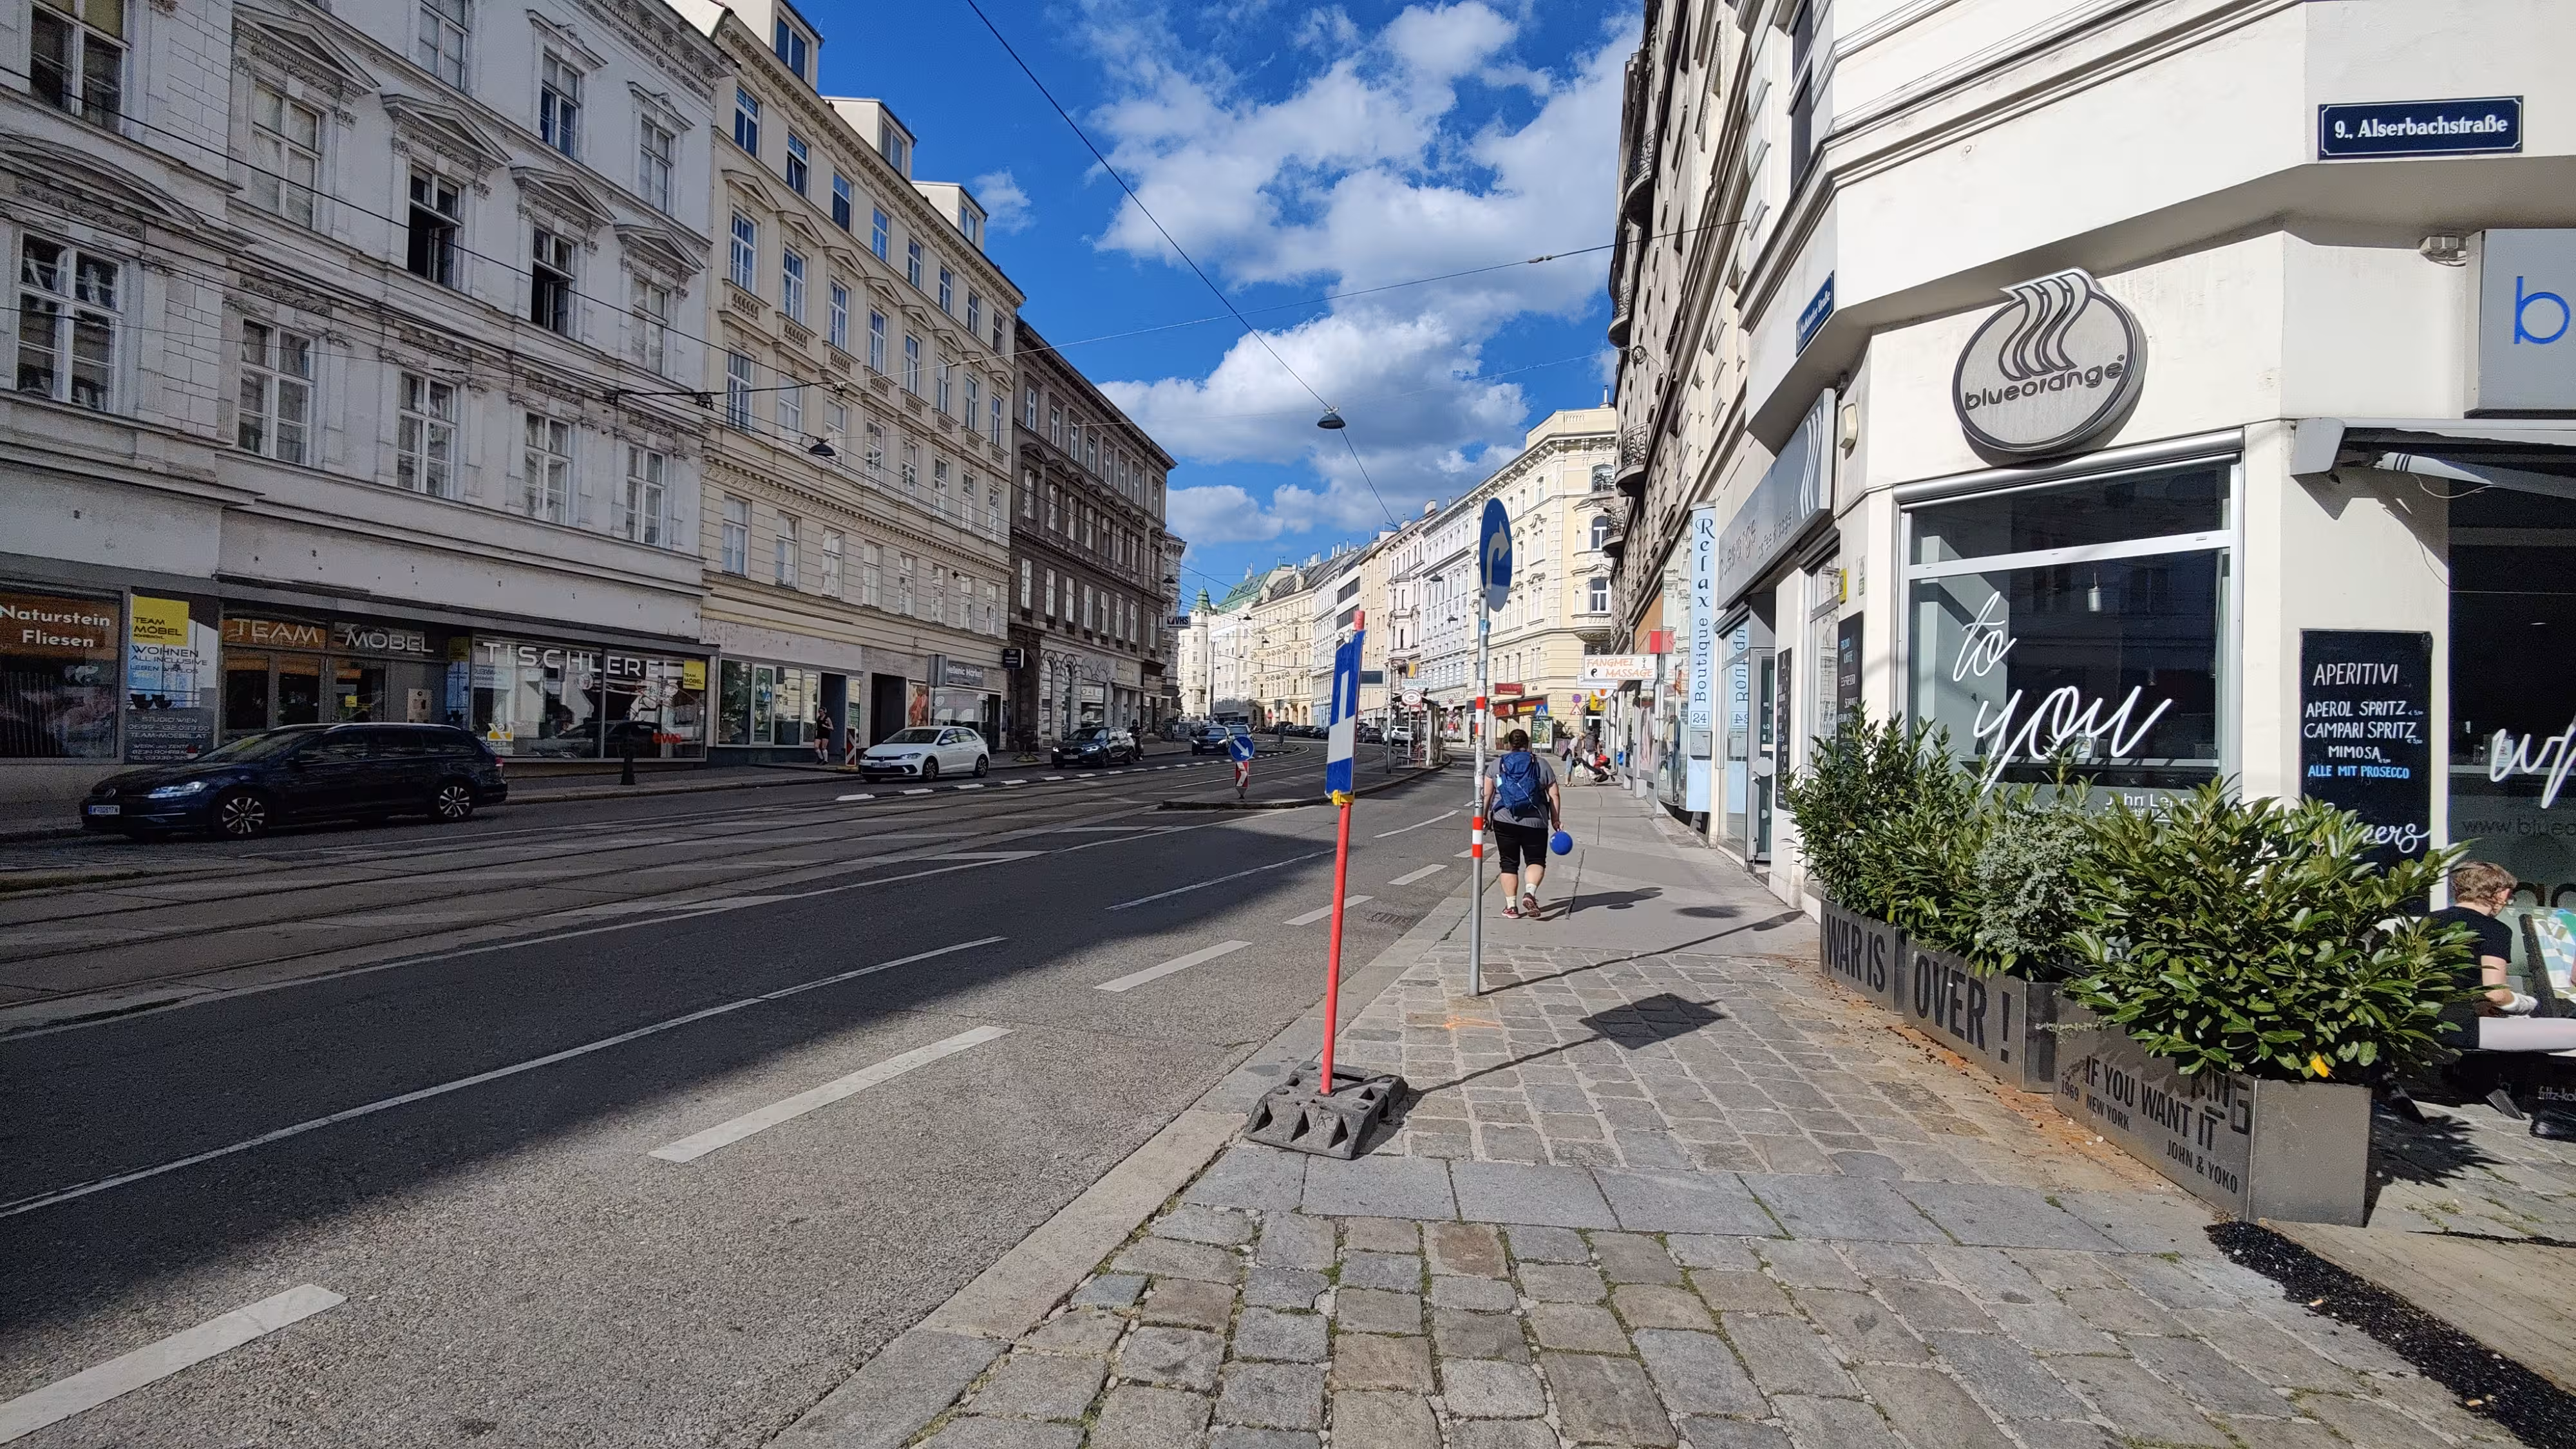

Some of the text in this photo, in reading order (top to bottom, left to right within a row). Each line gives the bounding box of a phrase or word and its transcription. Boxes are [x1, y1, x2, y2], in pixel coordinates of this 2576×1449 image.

[2357, 114, 2508, 137] Alserbachstraße
[1818, 290, 1831, 313] Straße
[1965, 362, 2123, 411] blueorange
[0, 604, 110, 627] Naturstein
[134, 616, 165, 625] TEAM
[1175, 616, 1189, 625] VHS
[23, 629, 94, 647] Fliesen
[134, 625, 182, 636] MÖBEL
[232, 618, 319, 643] TEAM
[345, 627, 434, 652] MÖBEL
[1953, 591, 2017, 681] to
[131, 645, 198, 658] WOHNEN
[154, 657, 208, 666] INCLUSIVE
[483, 641, 667, 679] TISCHLEREI
[1586, 658, 1634, 667] FANGMEI
[1694, 618, 1710, 703] Boutique
[966, 668, 983, 678] Market
[1605, 668, 1654, 677] MASSAGE
[2313, 663, 2398, 686] APERITIVI
[1692, 713, 1707, 723] 24
[2306, 701, 2353, 718] APEROL
[2359, 700, 2407, 717] SPRITZ
[1973, 685, 2174, 797] you
[2304, 721, 2416, 739] CAMPARI SPRITZ
[2328, 745, 2381, 760] MIMOSA
[2307, 765, 2410, 779] ALLE MIT PROSECCO
[1826, 913, 1886, 992] WAR IS
[1914, 955, 1987, 1052] OVER
[2061, 1079, 2130, 1132] 1969 NEW YORK
[2086, 1055, 2217, 1151] IF YOU WANT IT
[2166, 1139, 2238, 1193] JOHN & YOKO
